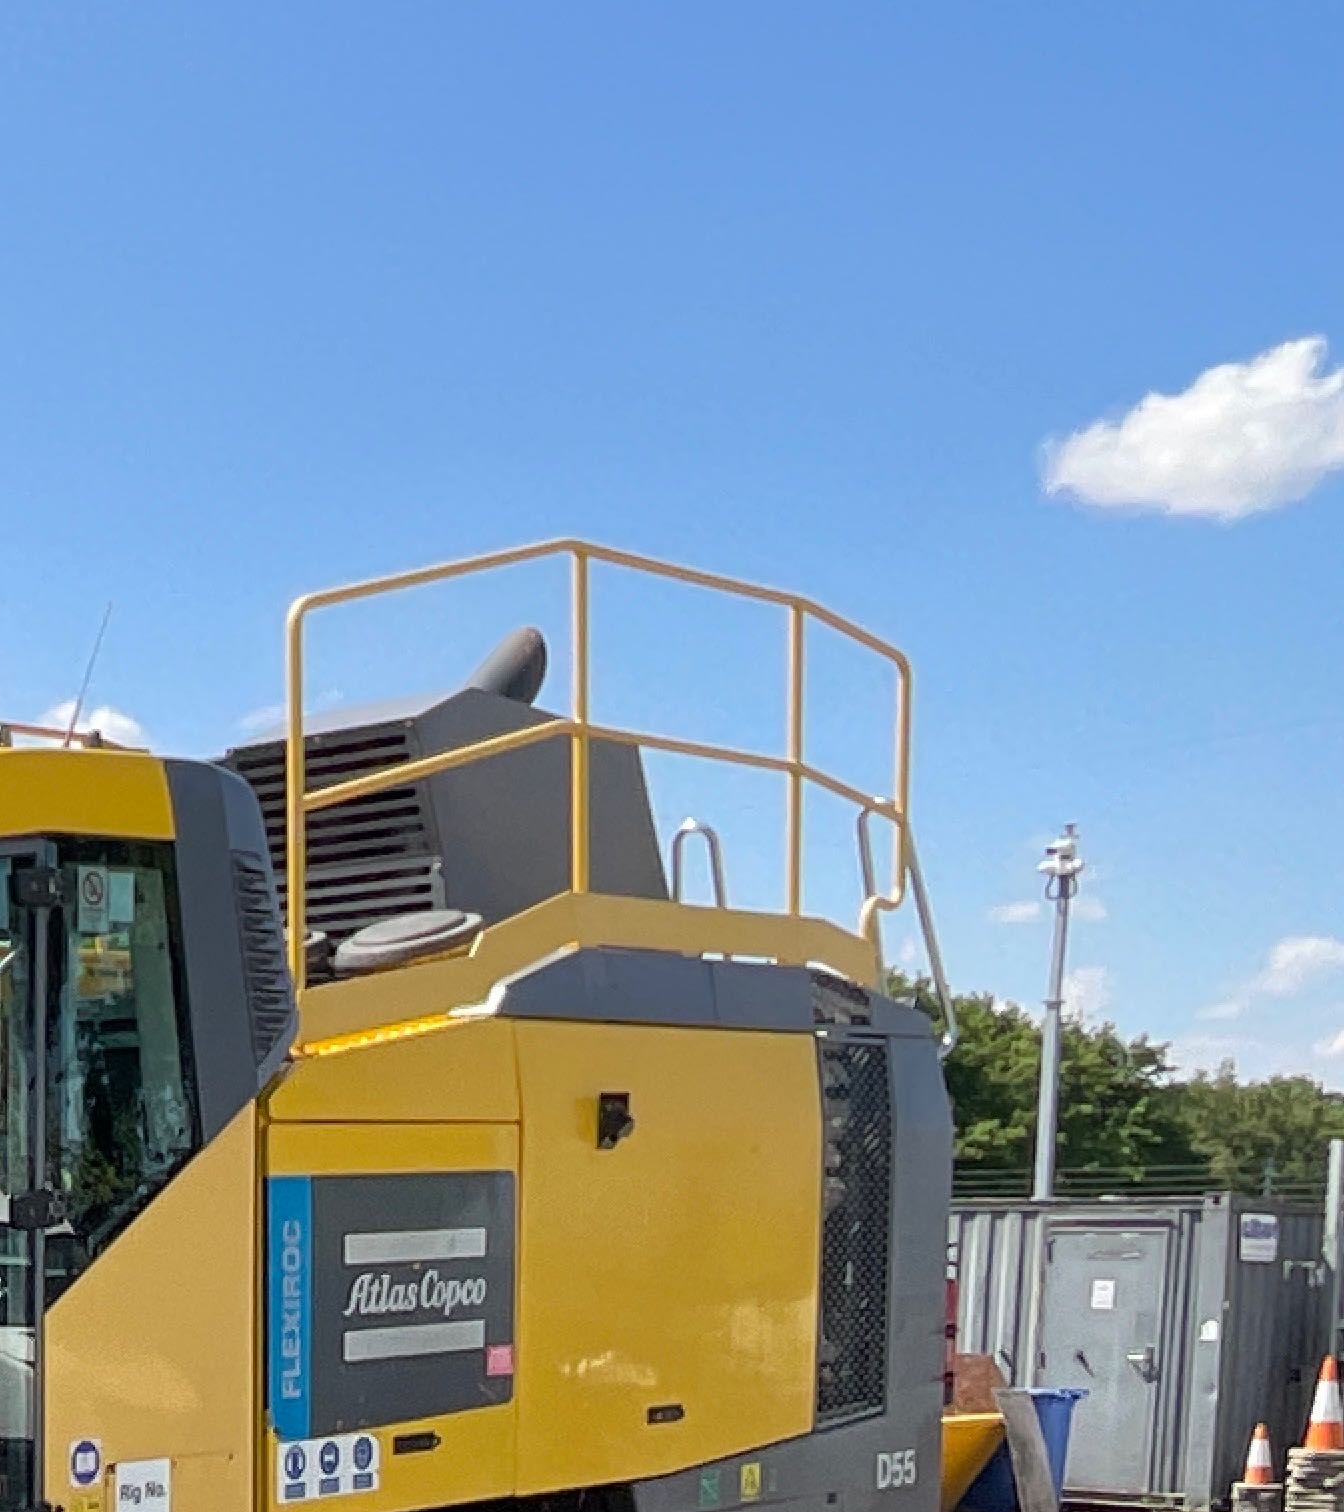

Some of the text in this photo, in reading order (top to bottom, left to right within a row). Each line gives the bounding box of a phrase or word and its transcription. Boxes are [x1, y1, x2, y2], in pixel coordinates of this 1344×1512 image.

[282, 1220, 302, 1399] FLEXIROC
[343, 1268, 486, 1316] Atlas Copco
[876, 1449, 916, 1489] D55
[120, 1483, 142, 1506] Rig
